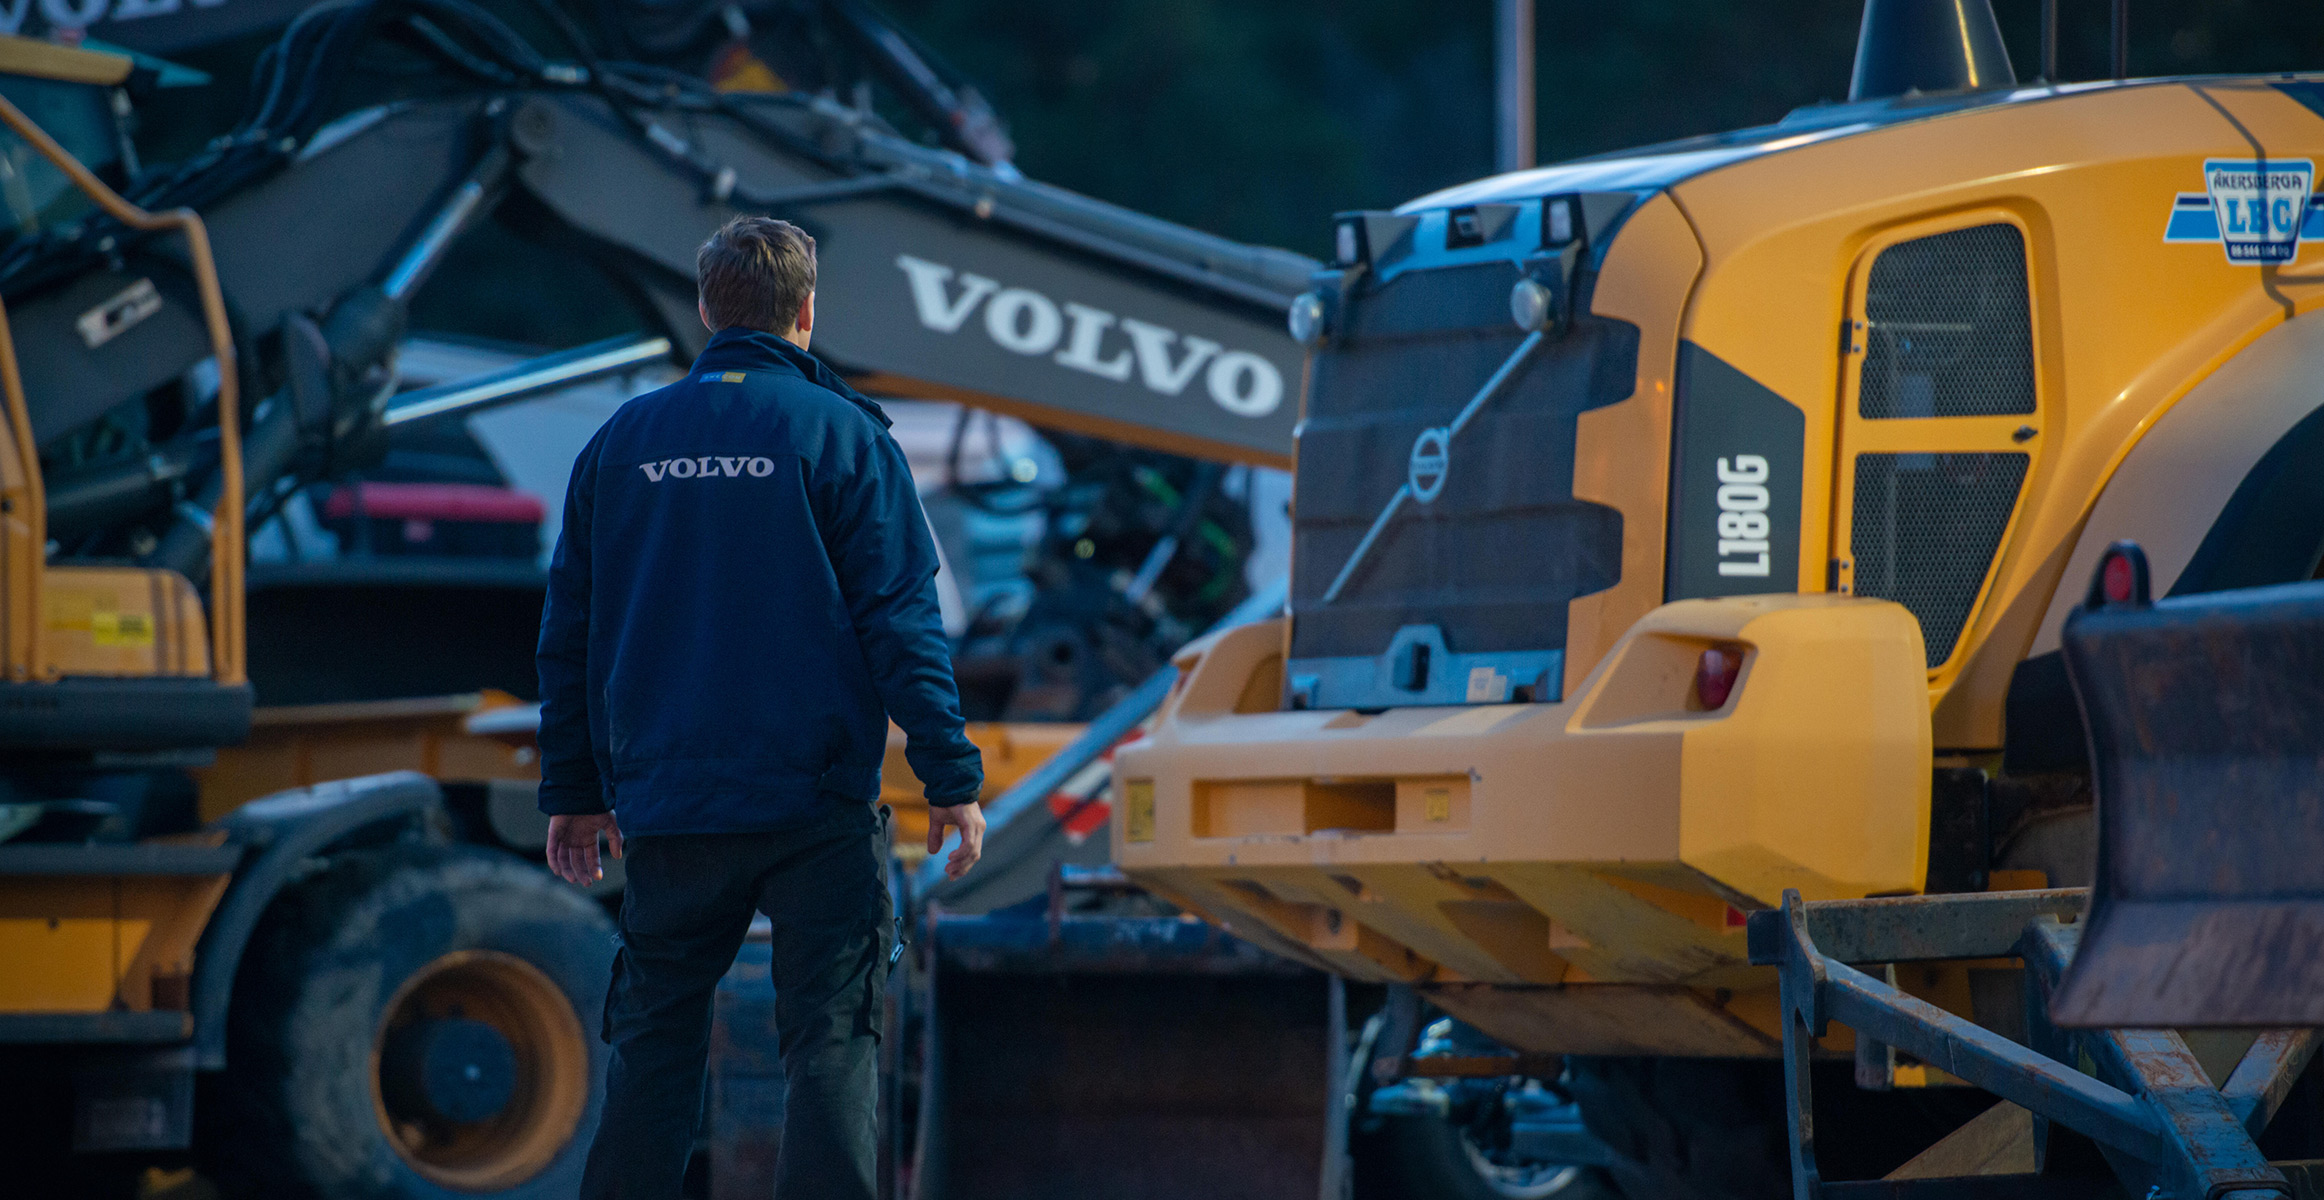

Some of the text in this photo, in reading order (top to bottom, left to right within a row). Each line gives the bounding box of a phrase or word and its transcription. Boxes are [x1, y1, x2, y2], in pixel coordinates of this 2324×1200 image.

[2213, 168, 2302, 190] ÅKERSBERGA
[2226, 199, 2292, 233] LBC
[898, 254, 1284, 418] VOLVO
[639, 456, 775, 483] VOLVO
[1717, 454, 1770, 576] L180G
